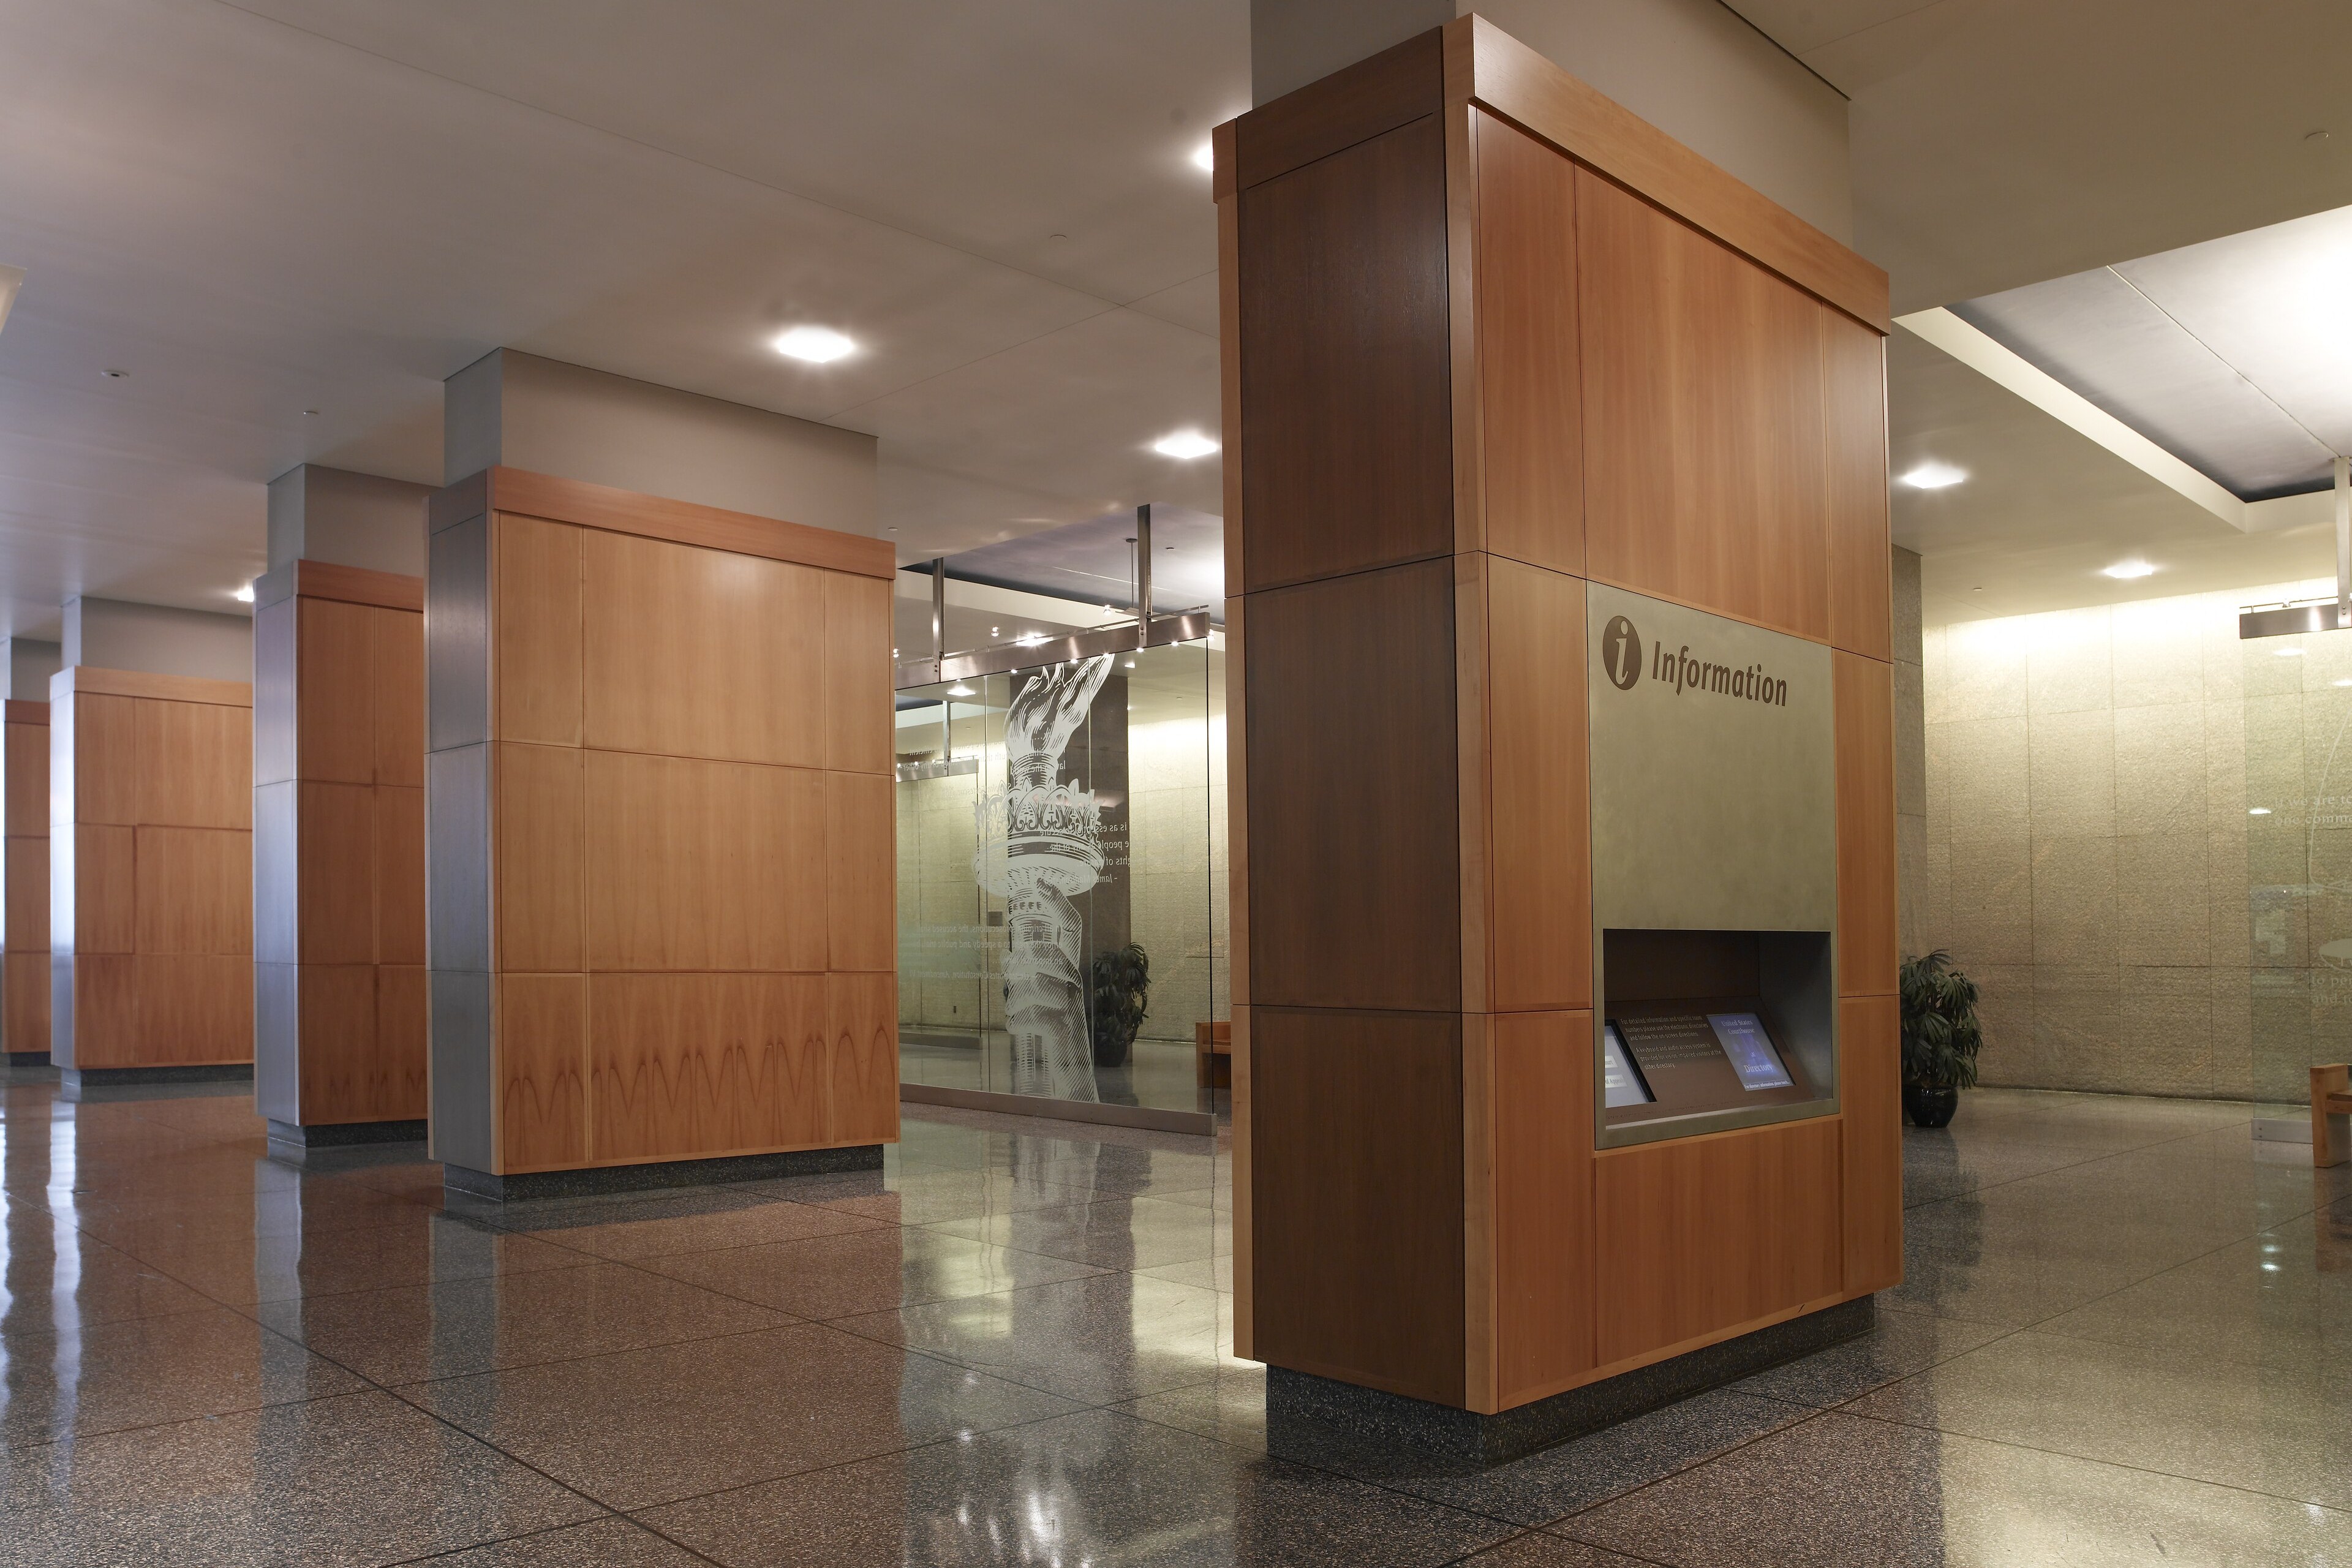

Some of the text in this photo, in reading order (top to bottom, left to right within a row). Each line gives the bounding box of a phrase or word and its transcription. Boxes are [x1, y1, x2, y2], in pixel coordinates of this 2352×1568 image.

[1652, 640, 1787, 707] Information
[2313, 796, 2335, 805] are
[2312, 976, 2324, 985] to
[1646, 1016, 1669, 1024] information
[1677, 1014, 1692, 1023] specific
[1643, 1025, 1656, 1033] please
[1689, 1022, 1709, 1030] directories
[1679, 1030, 1699, 1039] directions.
[1639, 1046, 1659, 1054] keyboard
[1743, 1063, 1774, 1073] Directory
